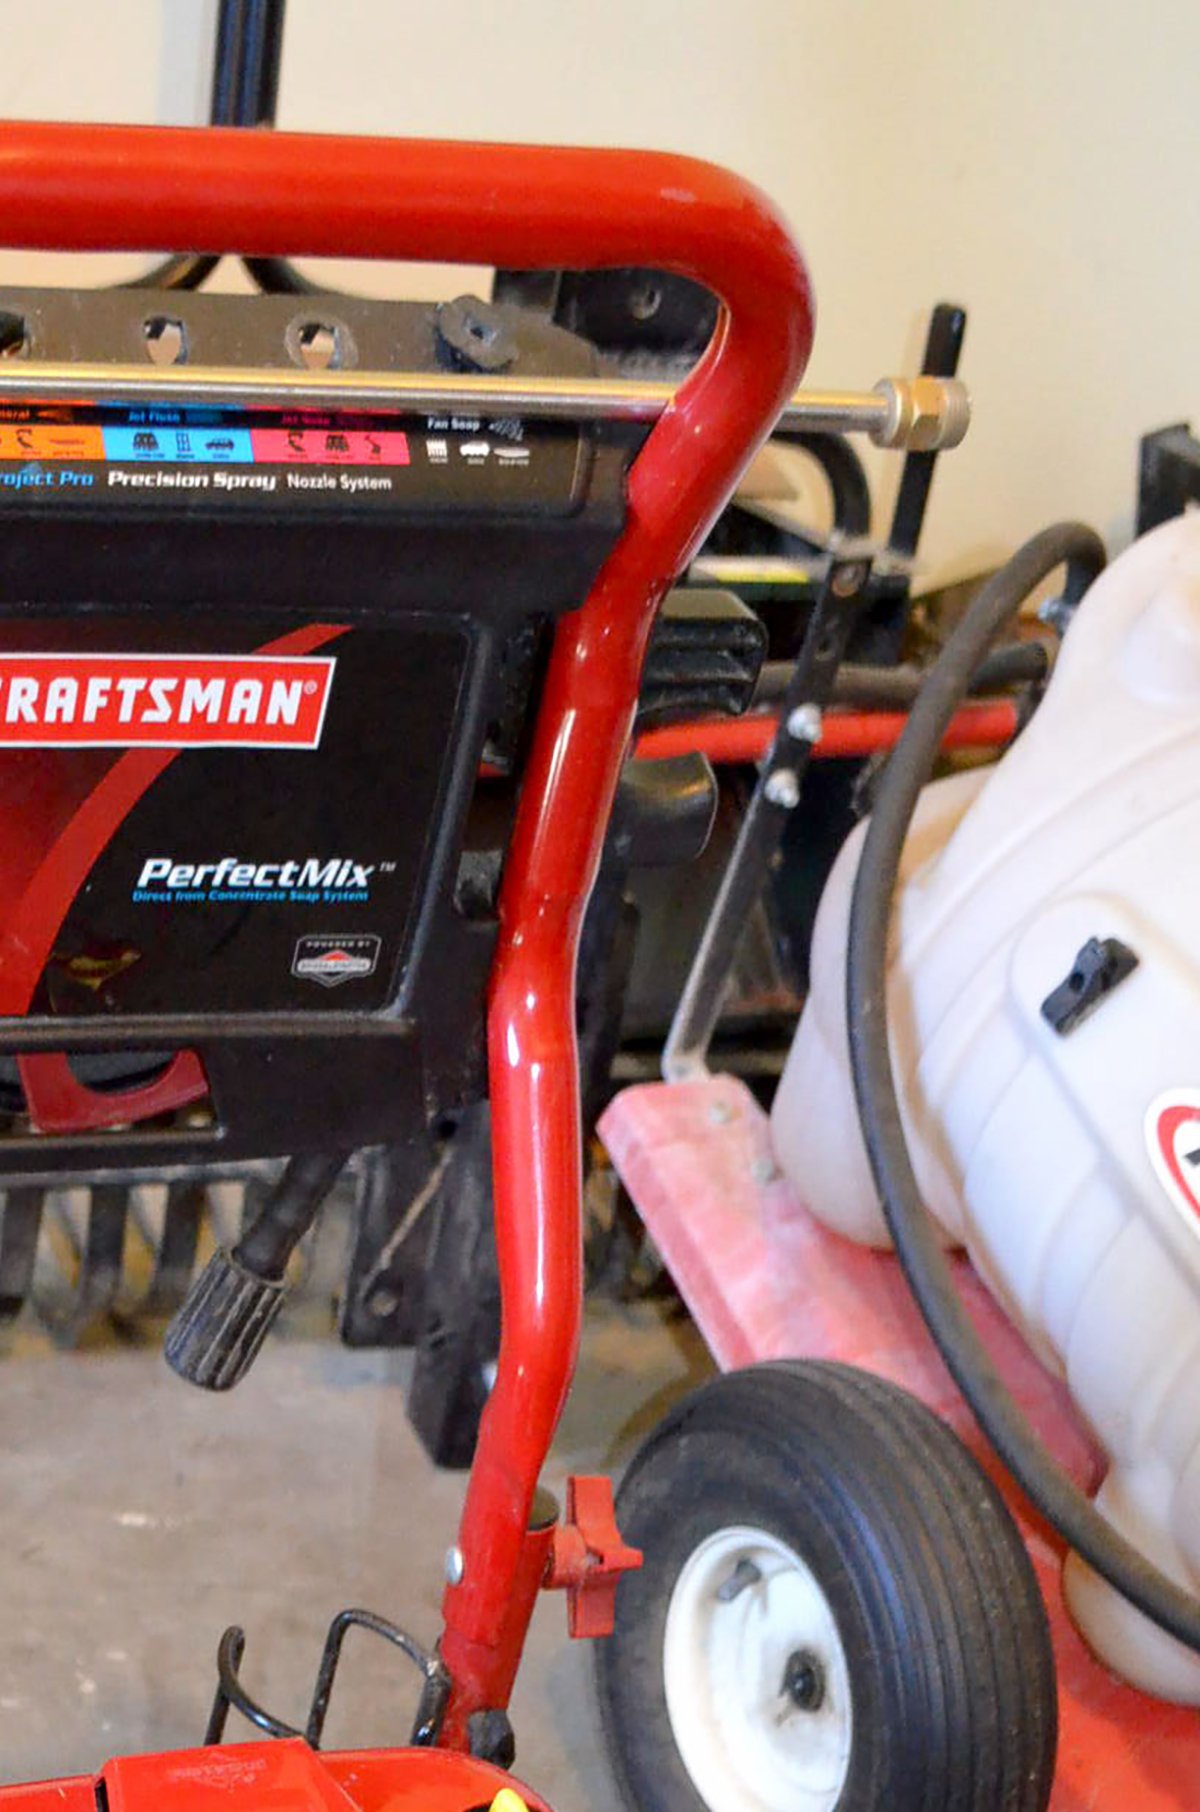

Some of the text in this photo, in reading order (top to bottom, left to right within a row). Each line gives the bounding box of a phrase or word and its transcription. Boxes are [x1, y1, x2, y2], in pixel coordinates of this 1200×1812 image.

[427, 417, 449, 430] Fan
[58, 470, 94, 486] Pro
[107, 470, 392, 492] Precision Spray Nozzle System
[136, 857, 375, 888] PerfectMix
[132, 890, 172, 903] Direct
[175, 890, 206, 902] from
[208, 890, 287, 902] Concentrate
[322, 890, 369, 904] System
